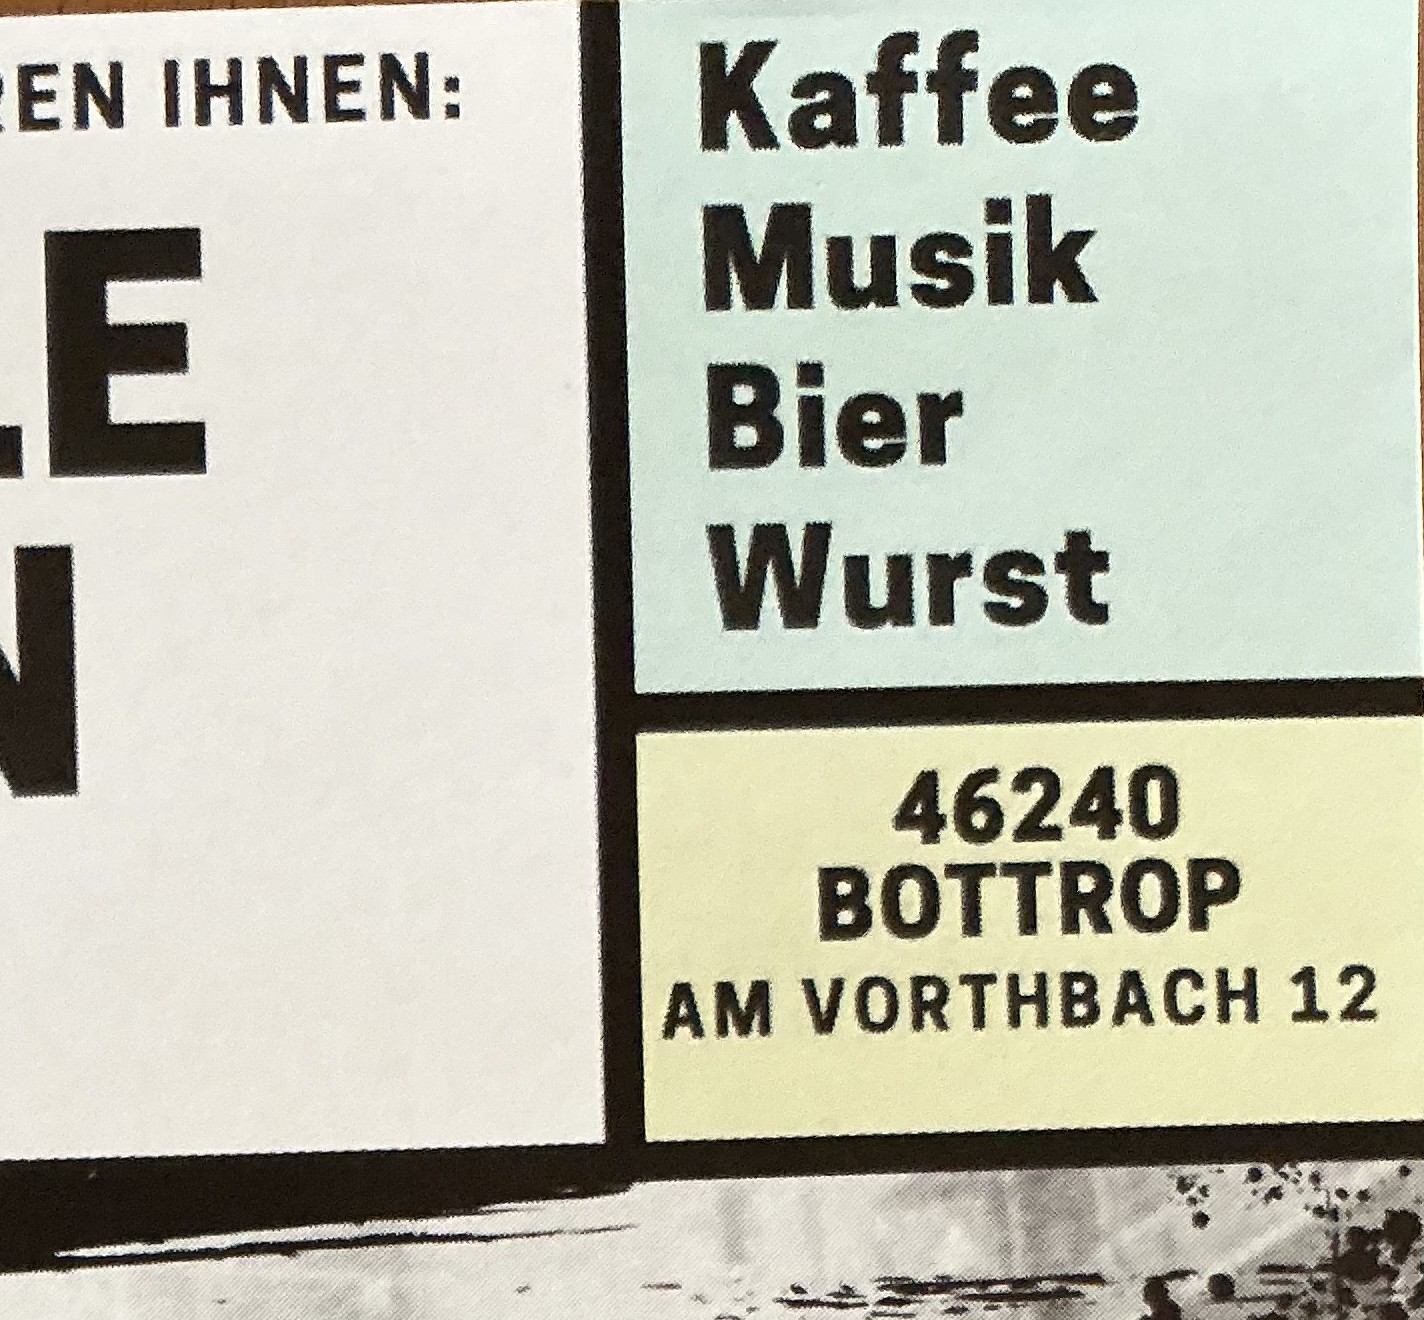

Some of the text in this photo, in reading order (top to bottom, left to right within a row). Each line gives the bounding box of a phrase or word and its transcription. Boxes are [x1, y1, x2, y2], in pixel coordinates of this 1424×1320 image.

[164, 52, 460, 127] IHNEN:
[699, 29, 1139, 151] Kaffee
[702, 193, 1098, 312] Musik
[706, 361, 964, 470] Bier
[706, 521, 1110, 631] Wurst
[894, 764, 1179, 845] 46240
[818, 857, 1241, 941] BOTTROP
[662, 964, 1377, 1039] AM VORTHBACH 12
